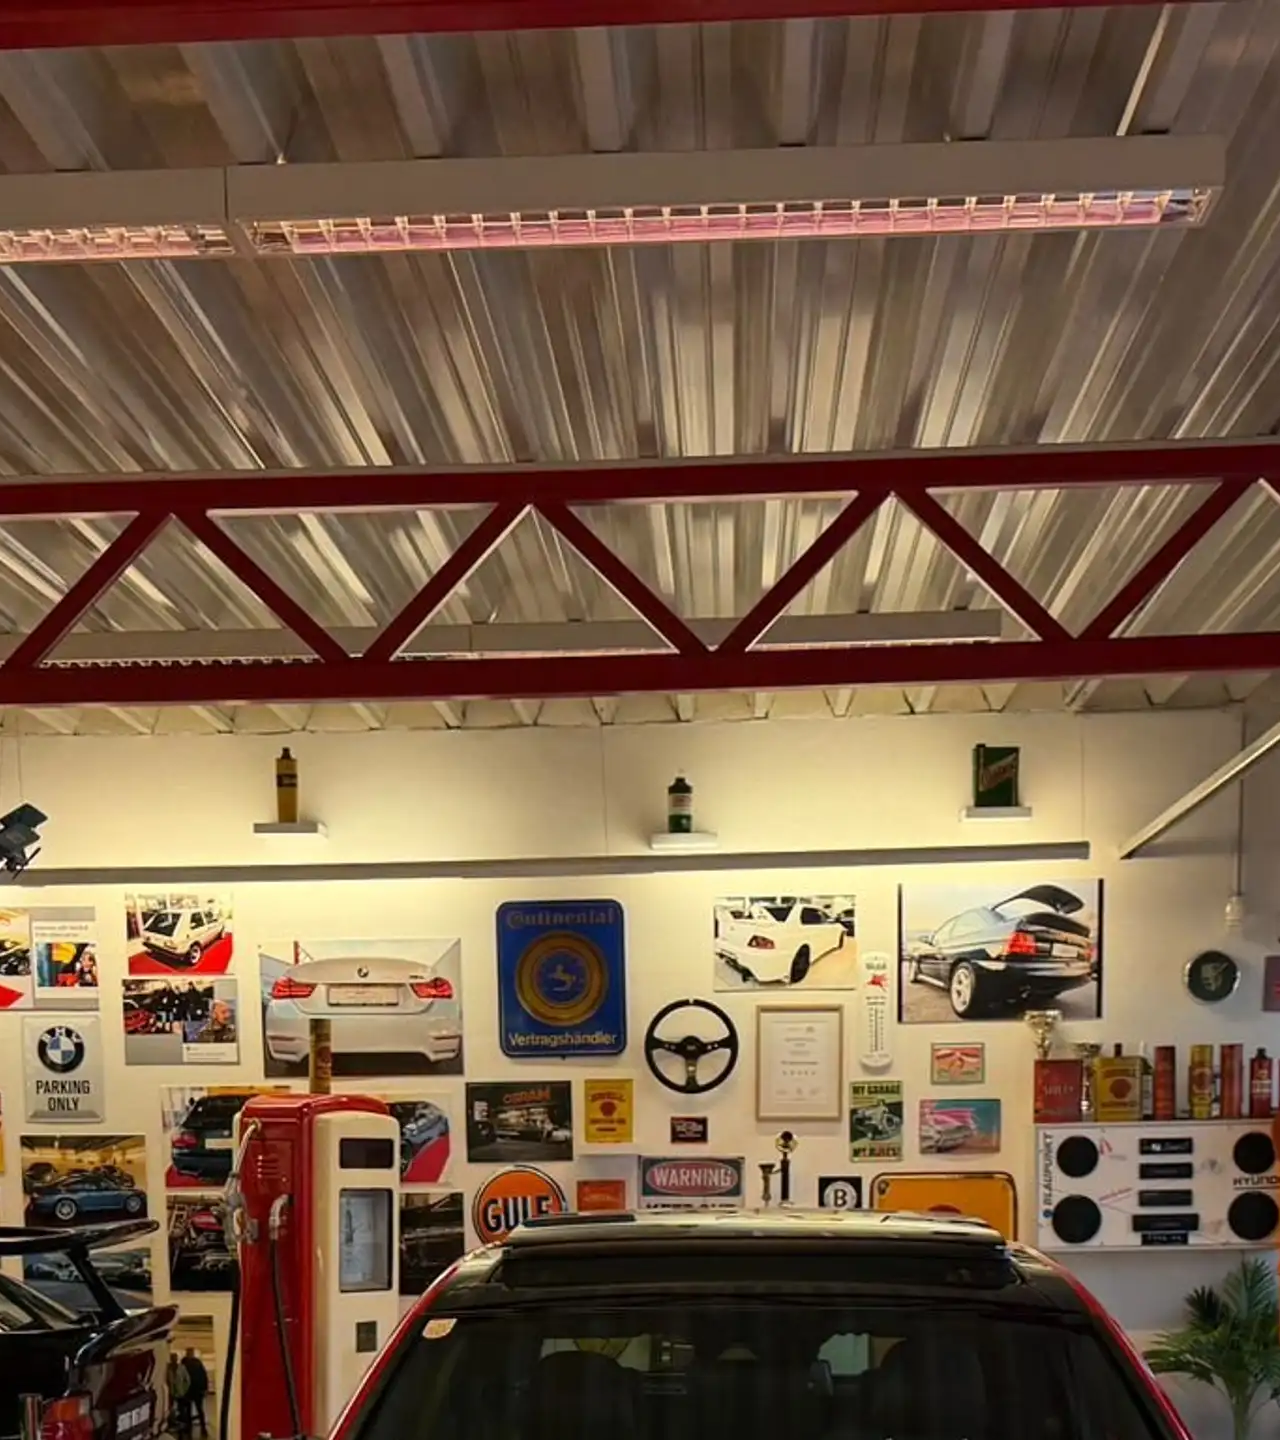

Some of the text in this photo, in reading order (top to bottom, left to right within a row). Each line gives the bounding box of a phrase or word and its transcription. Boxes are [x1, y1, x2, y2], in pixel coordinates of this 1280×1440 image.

[35, 1080, 90, 1095] PARKING
[47, 1096, 80, 1112] ONLY
[653, 1167, 732, 1187] WARNING
[1042, 1133, 1053, 1206] BLAUPUNKT
